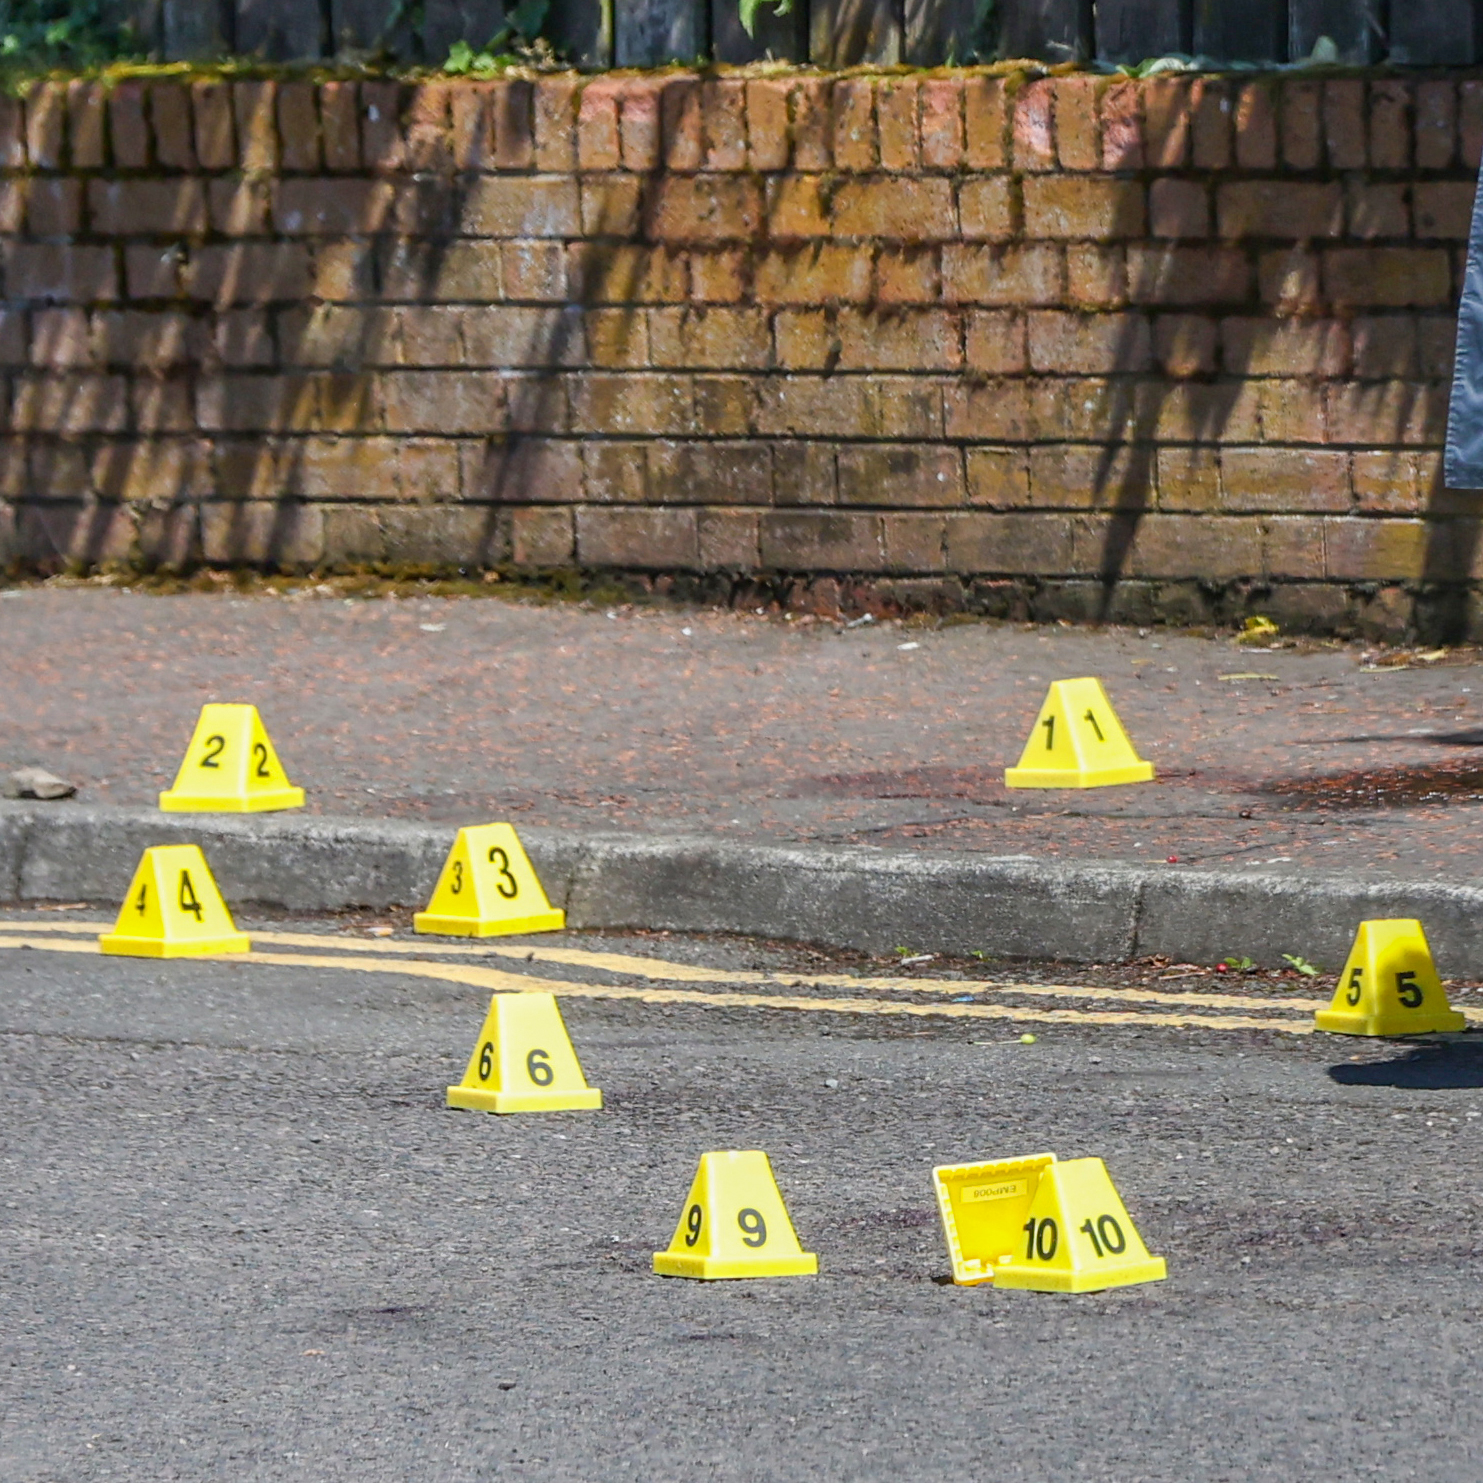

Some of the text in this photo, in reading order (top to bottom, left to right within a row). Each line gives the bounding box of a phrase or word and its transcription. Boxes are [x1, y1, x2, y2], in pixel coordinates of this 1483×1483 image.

[1042, 715, 1056, 751] 1
[1084, 709, 1104, 742] 1
[201, 735, 225, 768] 2
[253, 743, 270, 777] 2
[451, 860, 463, 895] 3
[488, 847, 518, 899] 3
[135, 884, 146, 917] 4
[179, 870, 203, 921] 4
[1347, 968, 1362, 1006] 5
[1396, 971, 1424, 1008] 5
[478, 1041, 495, 1081] 6
[526, 1049, 554, 1086] 6
[684, 1204, 701, 1247] 9
[737, 1208, 767, 1248] 9
[1023, 1218, 1058, 1261] 10
[1079, 1214, 1126, 1258] 10
